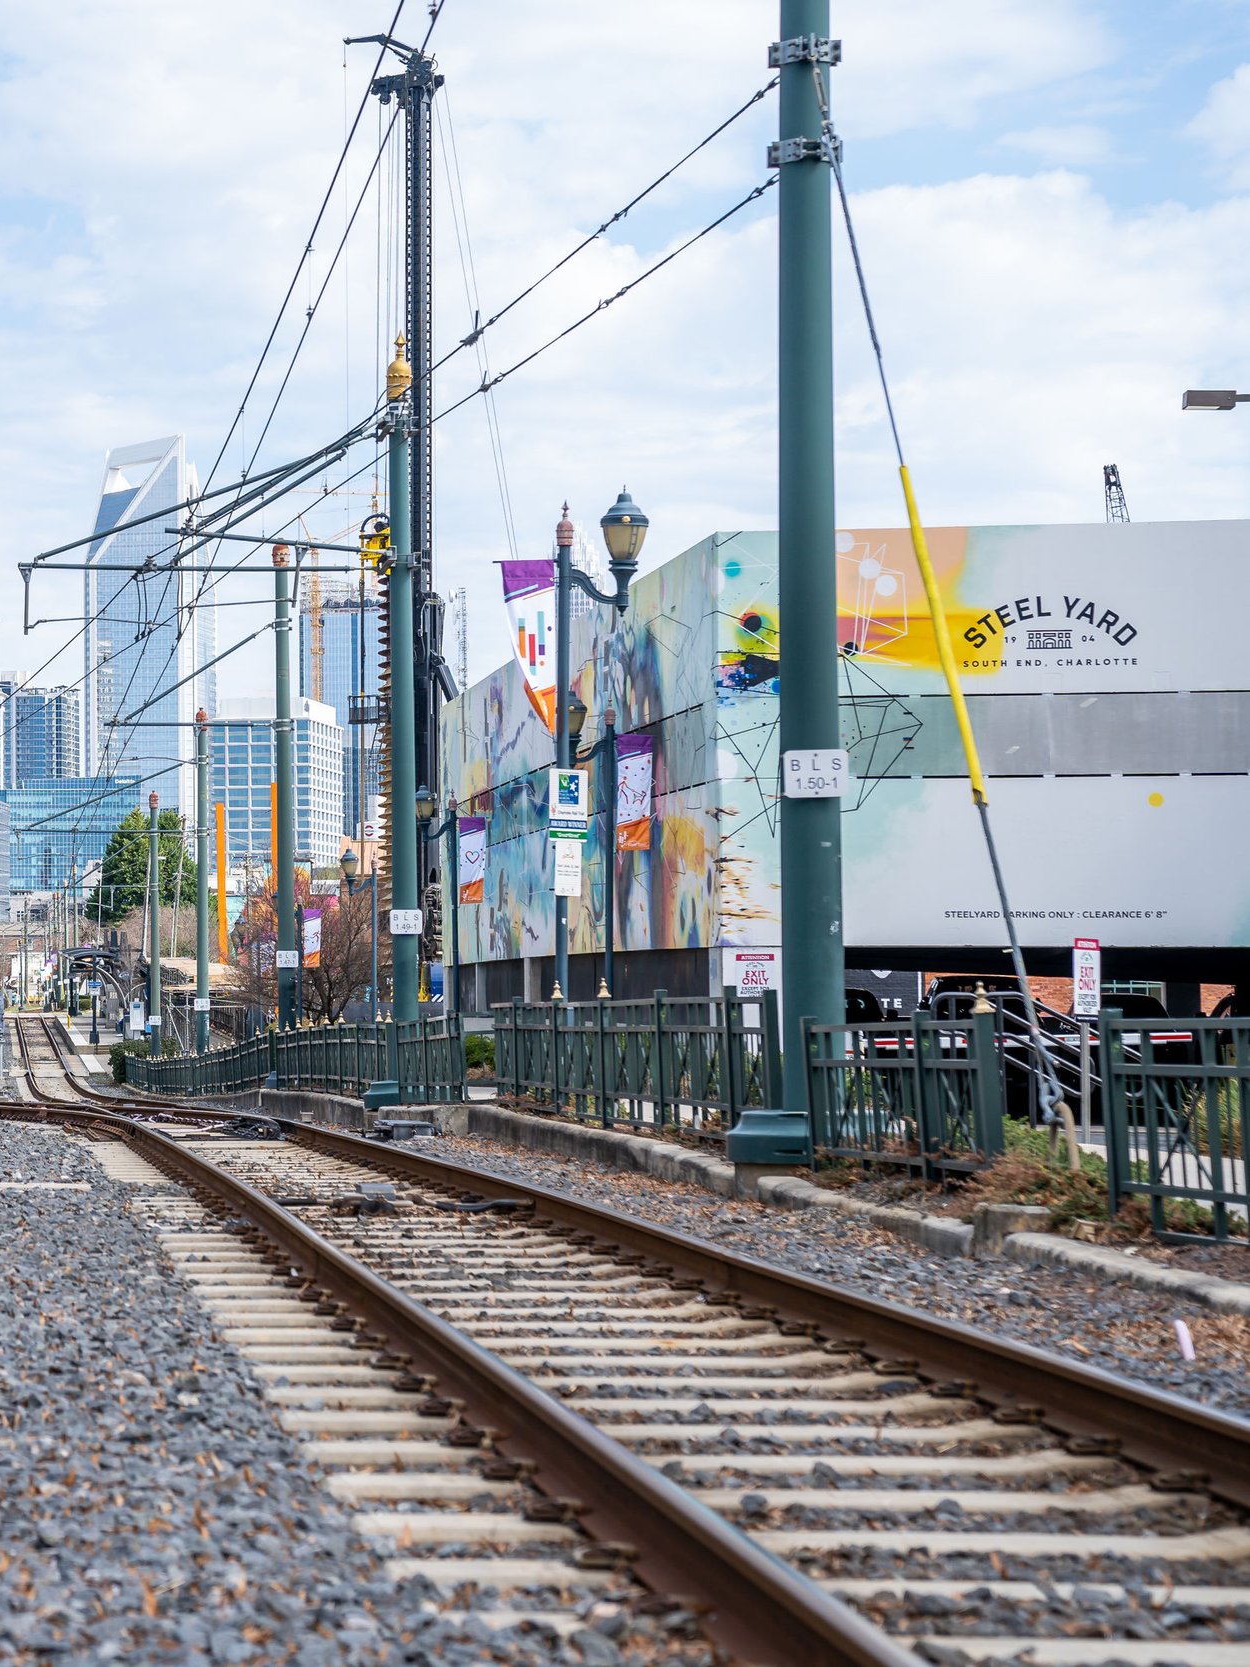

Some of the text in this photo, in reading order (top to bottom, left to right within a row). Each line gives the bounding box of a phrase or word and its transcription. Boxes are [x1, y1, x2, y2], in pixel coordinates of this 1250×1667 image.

[963, 595, 1138, 649] STEEL YARD
[963, 660, 1008, 668] SOUTH
[1056, 658, 1138, 666] CHARLOTTE
[796, 777, 838, 790] 1.50-1
[944, 911, 1000, 919] STEELYARD
[1048, 911, 1075, 919] ONLY
[745, 970, 766, 978] EXIT
[1080, 967, 1094, 978] EXIT
[1079, 978, 1096, 991] ONLY
